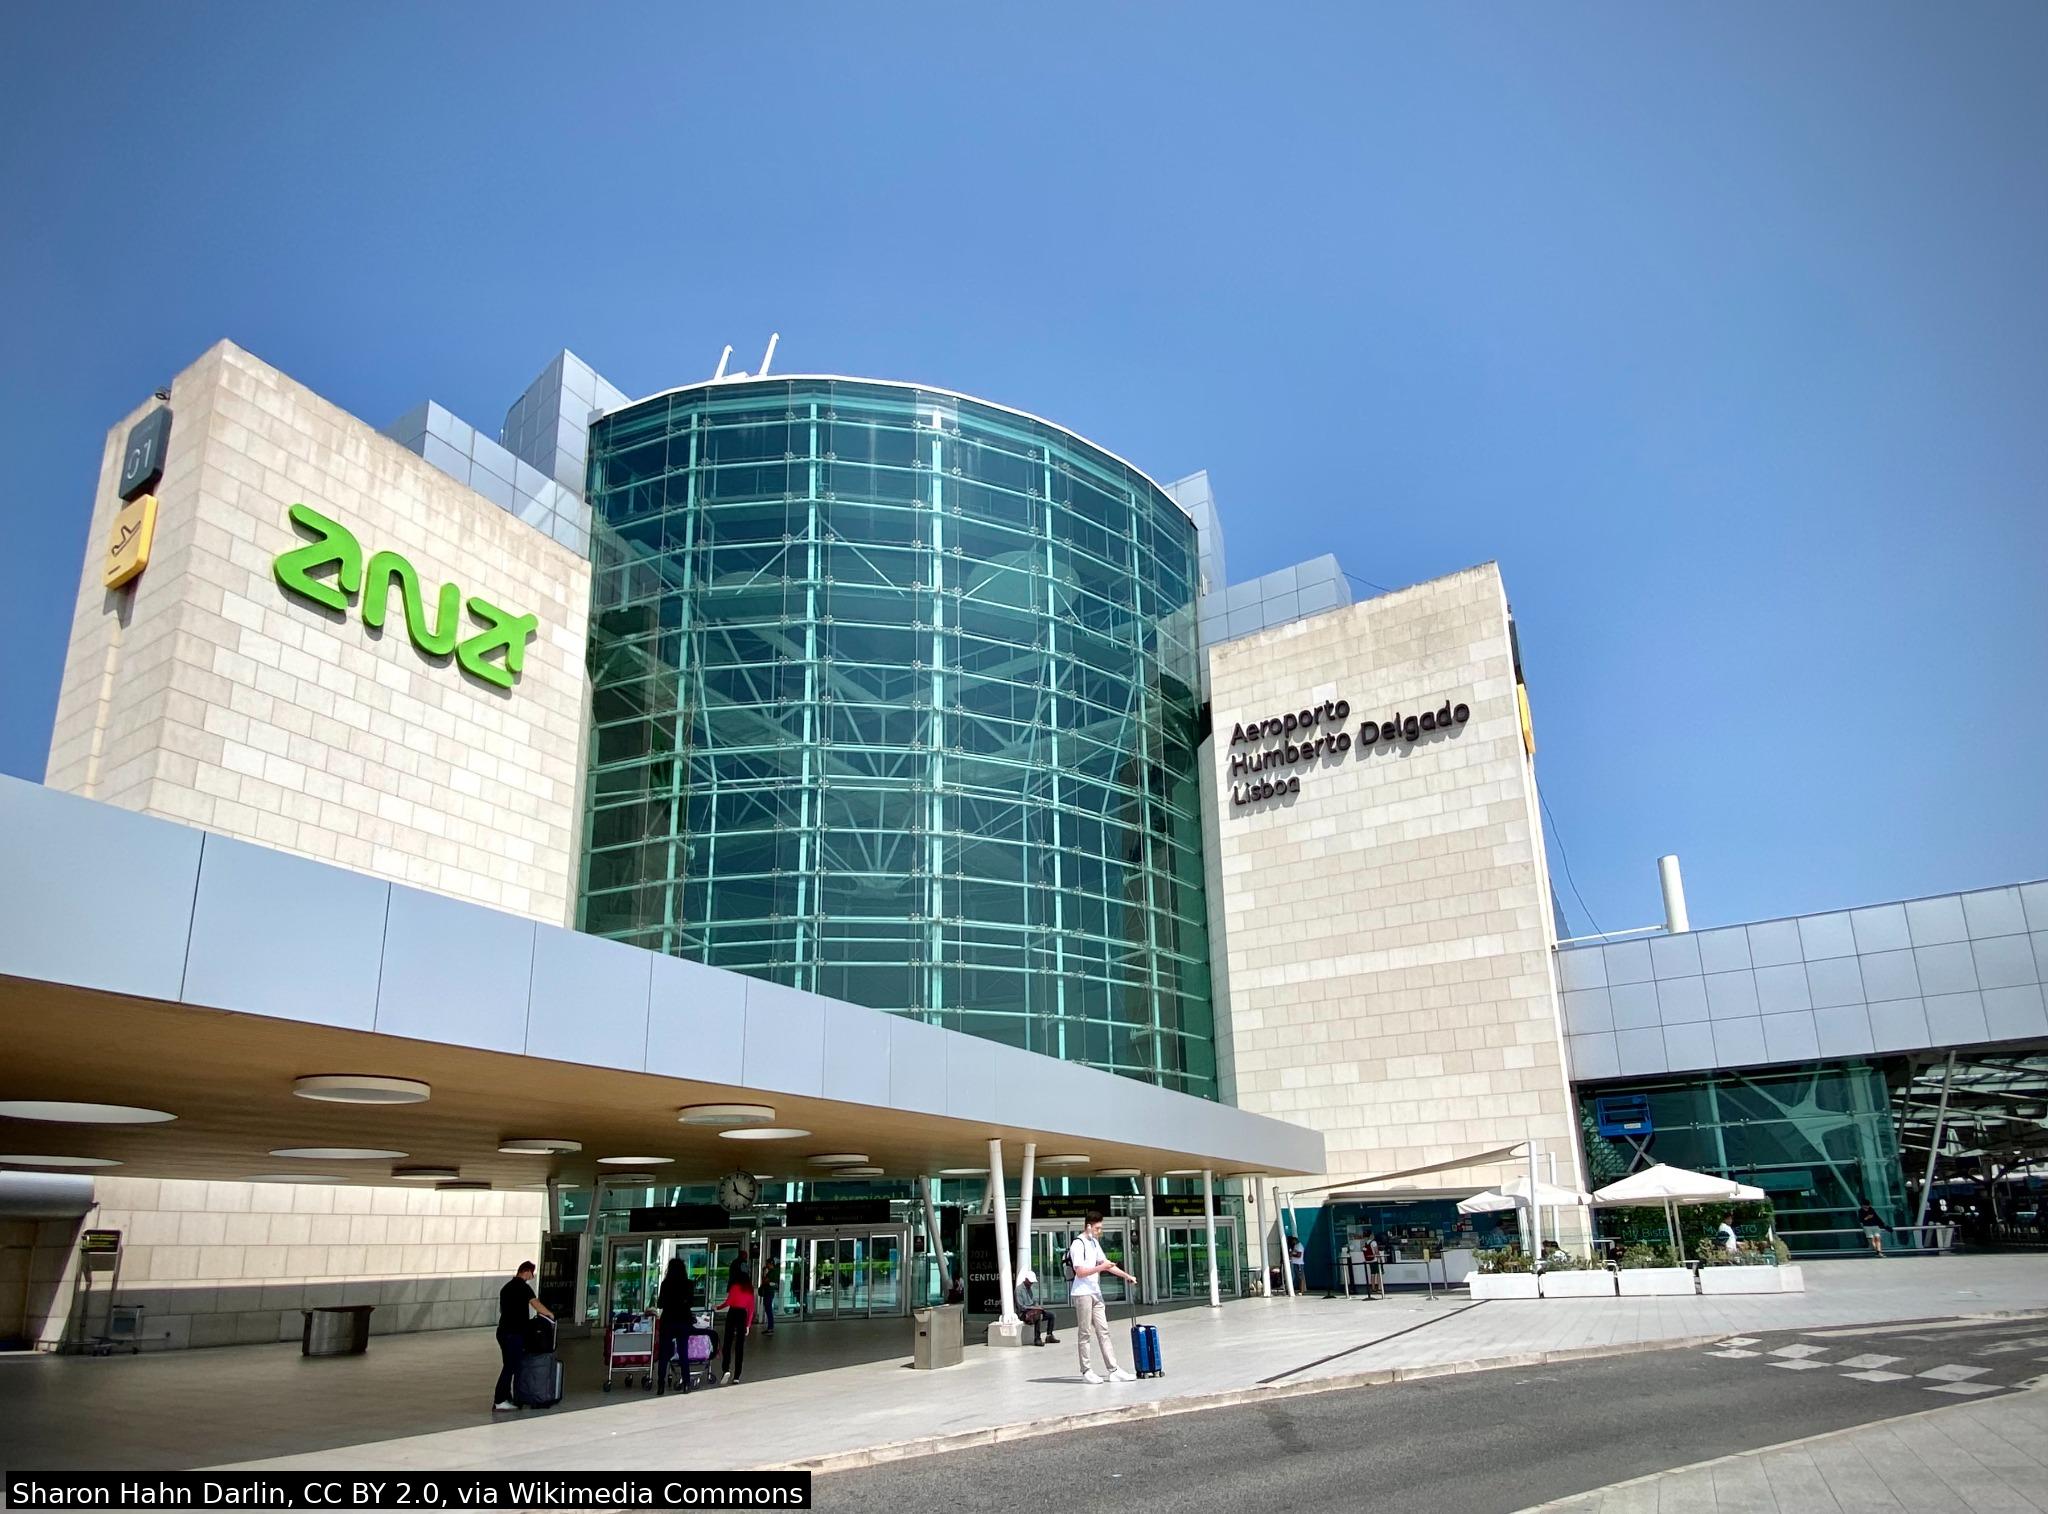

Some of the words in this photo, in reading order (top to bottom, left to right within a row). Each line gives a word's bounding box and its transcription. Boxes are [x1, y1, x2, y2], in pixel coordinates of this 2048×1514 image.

[127, 438, 152, 480] 01
[1231, 699, 1350, 746] Aeroporto
[1231, 731, 1351, 777] Humberto
[1360, 699, 1470, 746] Delgado
[1233, 776, 1300, 806] Lisboa
